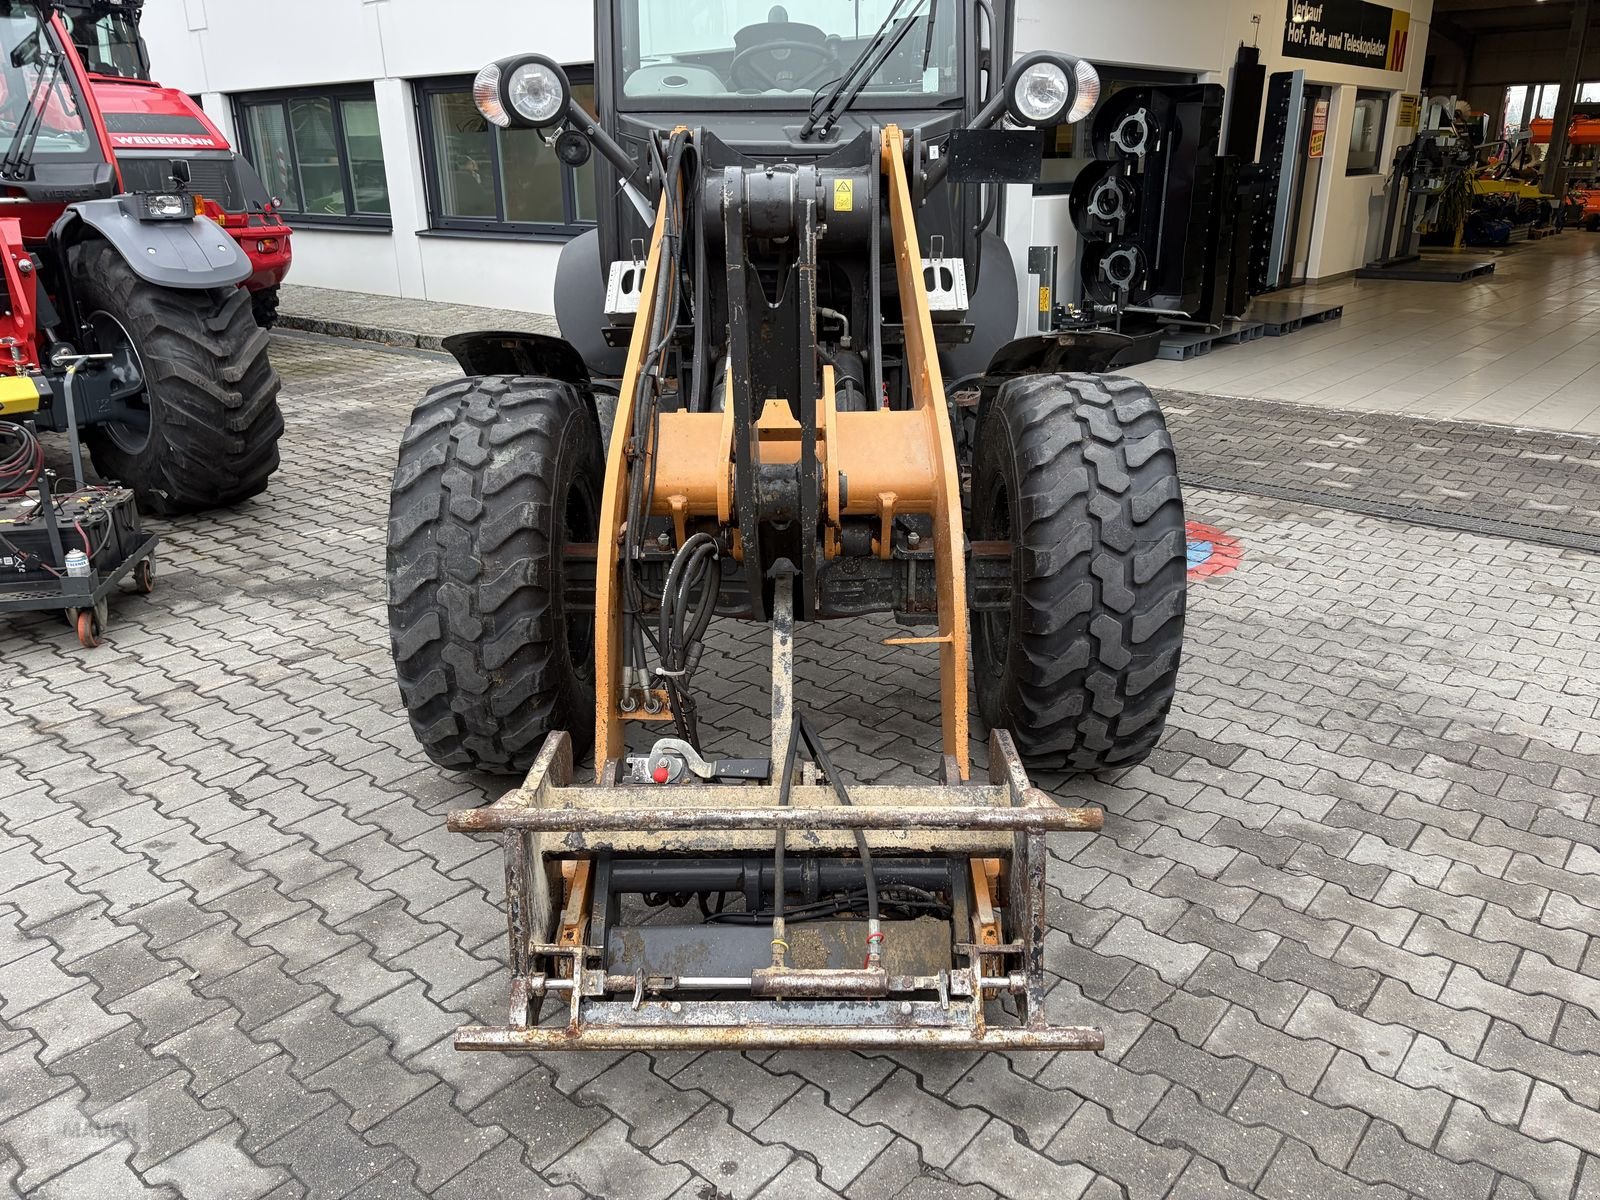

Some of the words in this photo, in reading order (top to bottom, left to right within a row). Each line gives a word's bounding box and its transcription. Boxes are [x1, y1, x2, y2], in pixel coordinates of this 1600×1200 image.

[1292, 0, 1323, 23] Verkauf
[1287, 22, 1308, 47] Hof-,
[1309, 26, 1327, 47] Rad-
[1328, 32, 1343, 50] und
[1343, 32, 1386, 59] Teleskoplader
[113, 136, 215, 146] WEIDEMANN
